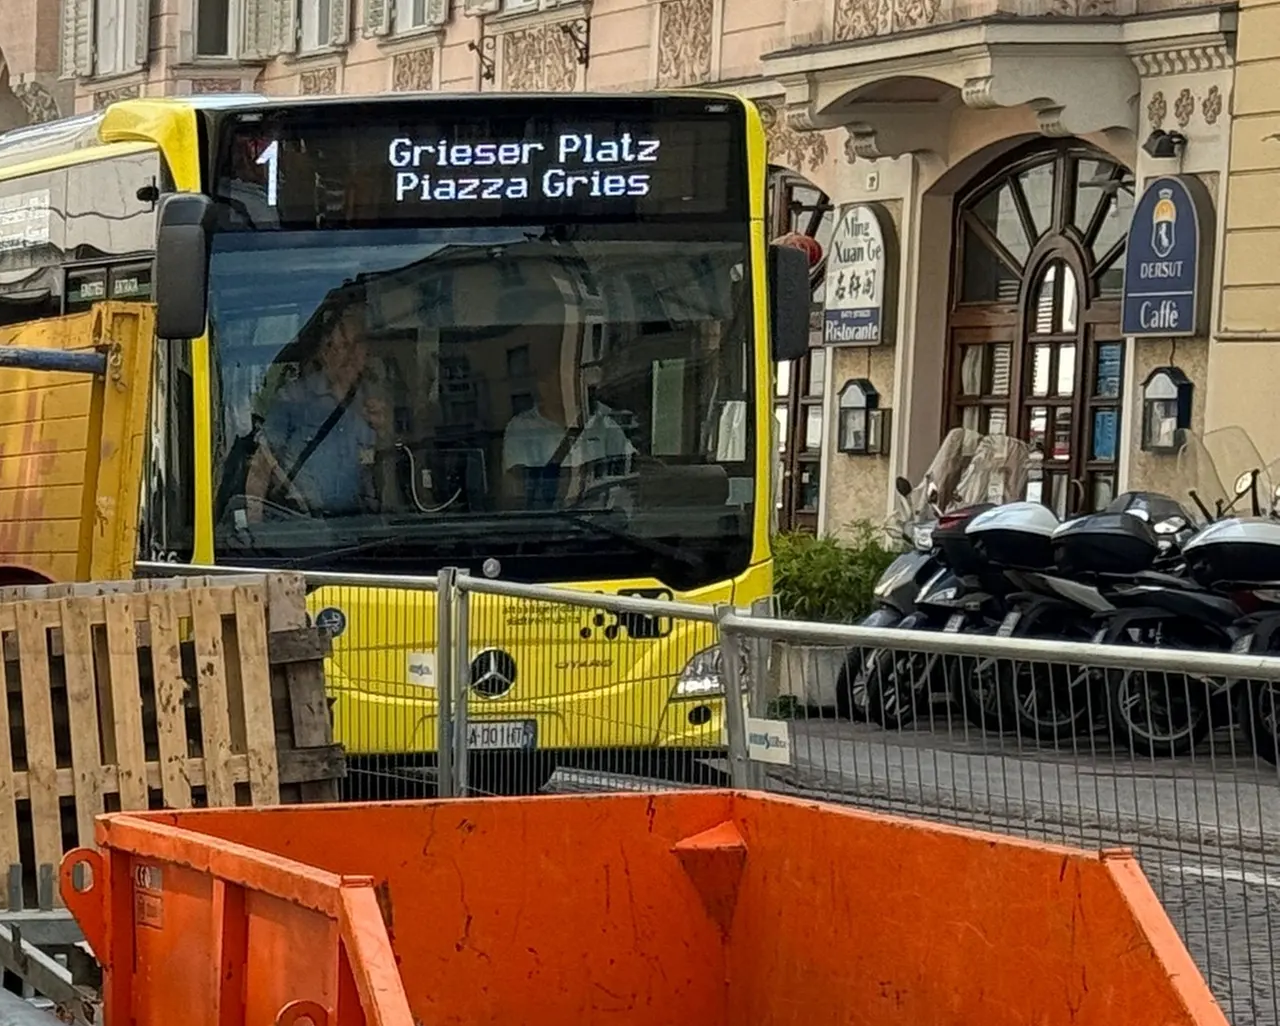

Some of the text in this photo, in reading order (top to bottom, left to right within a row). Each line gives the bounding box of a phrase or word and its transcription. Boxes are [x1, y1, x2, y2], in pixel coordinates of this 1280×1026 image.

[388, 132, 661, 168] Grieser Platz
[255, 140, 279, 207] 1
[395, 168, 651, 202] Piazza Gries
[843, 215, 870, 238] Ming
[834, 241, 864, 264] Xuan
[1140, 261, 1184, 279] DERSUT
[1140, 299, 1179, 329] Caffè
[826, 320, 878, 342] Ristorante
